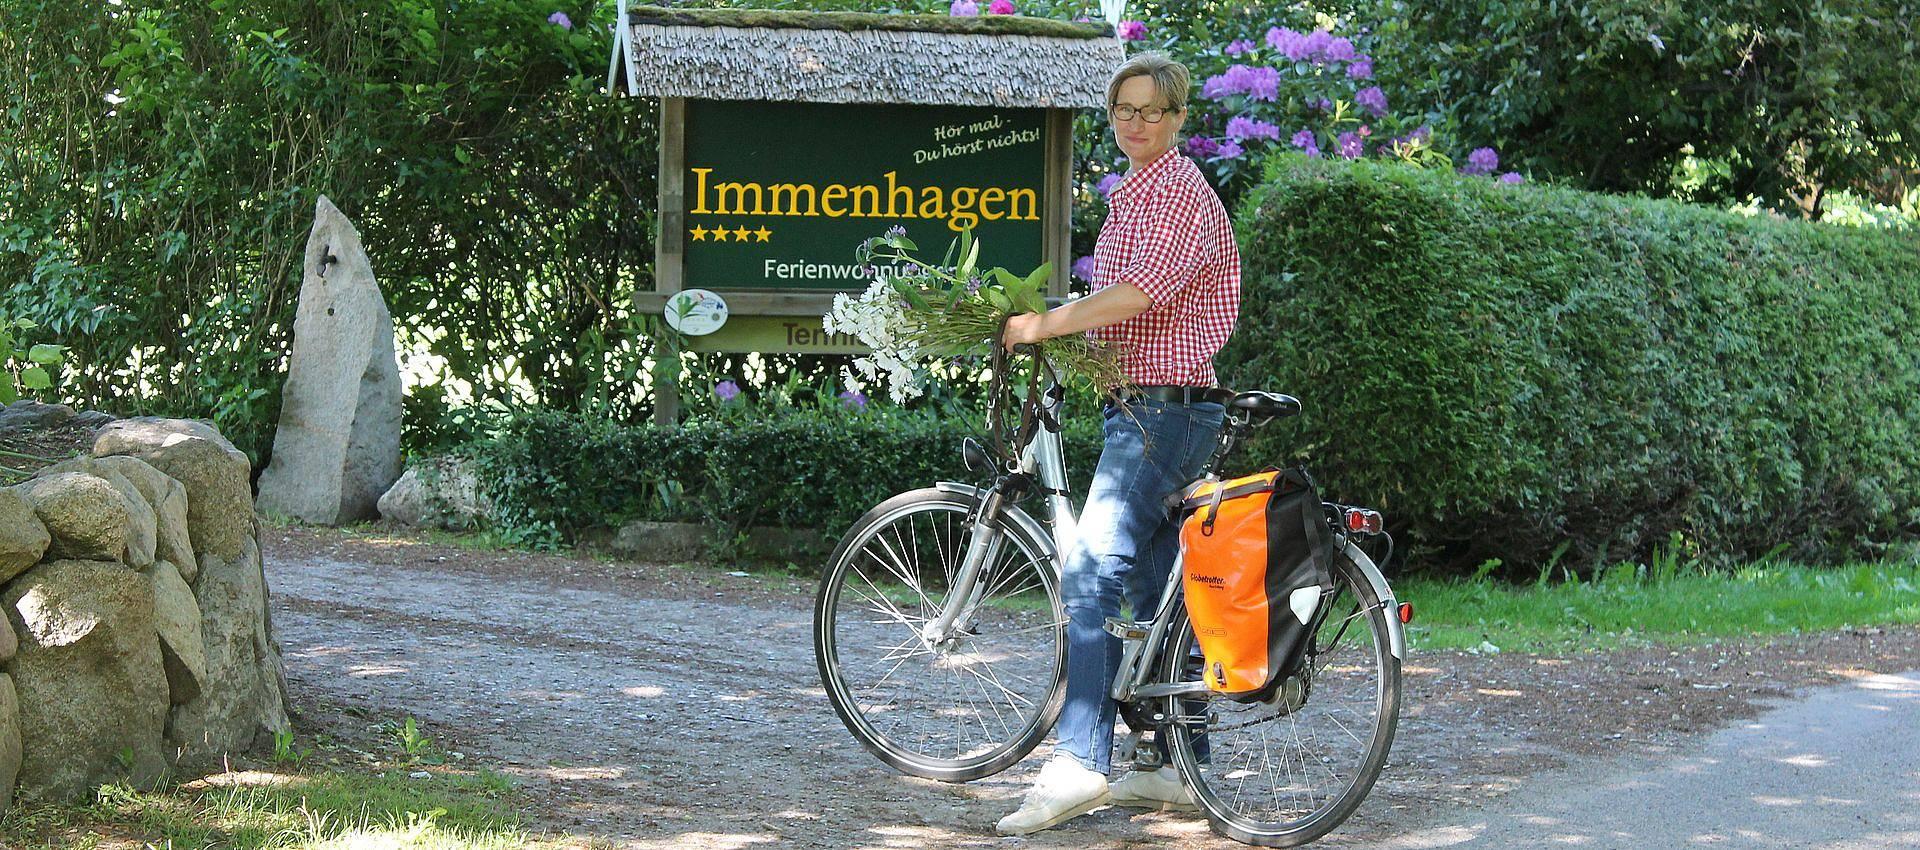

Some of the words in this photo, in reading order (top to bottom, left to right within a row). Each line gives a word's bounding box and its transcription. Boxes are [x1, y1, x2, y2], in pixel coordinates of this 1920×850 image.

[913, 149, 941, 165] Du
[941, 138, 985, 159] hörst
[987, 127, 1040, 150] nichts!
[934, 124, 965, 142] Hör
[969, 114, 1003, 134] mal
[690, 167, 1041, 232] Immenhagen
